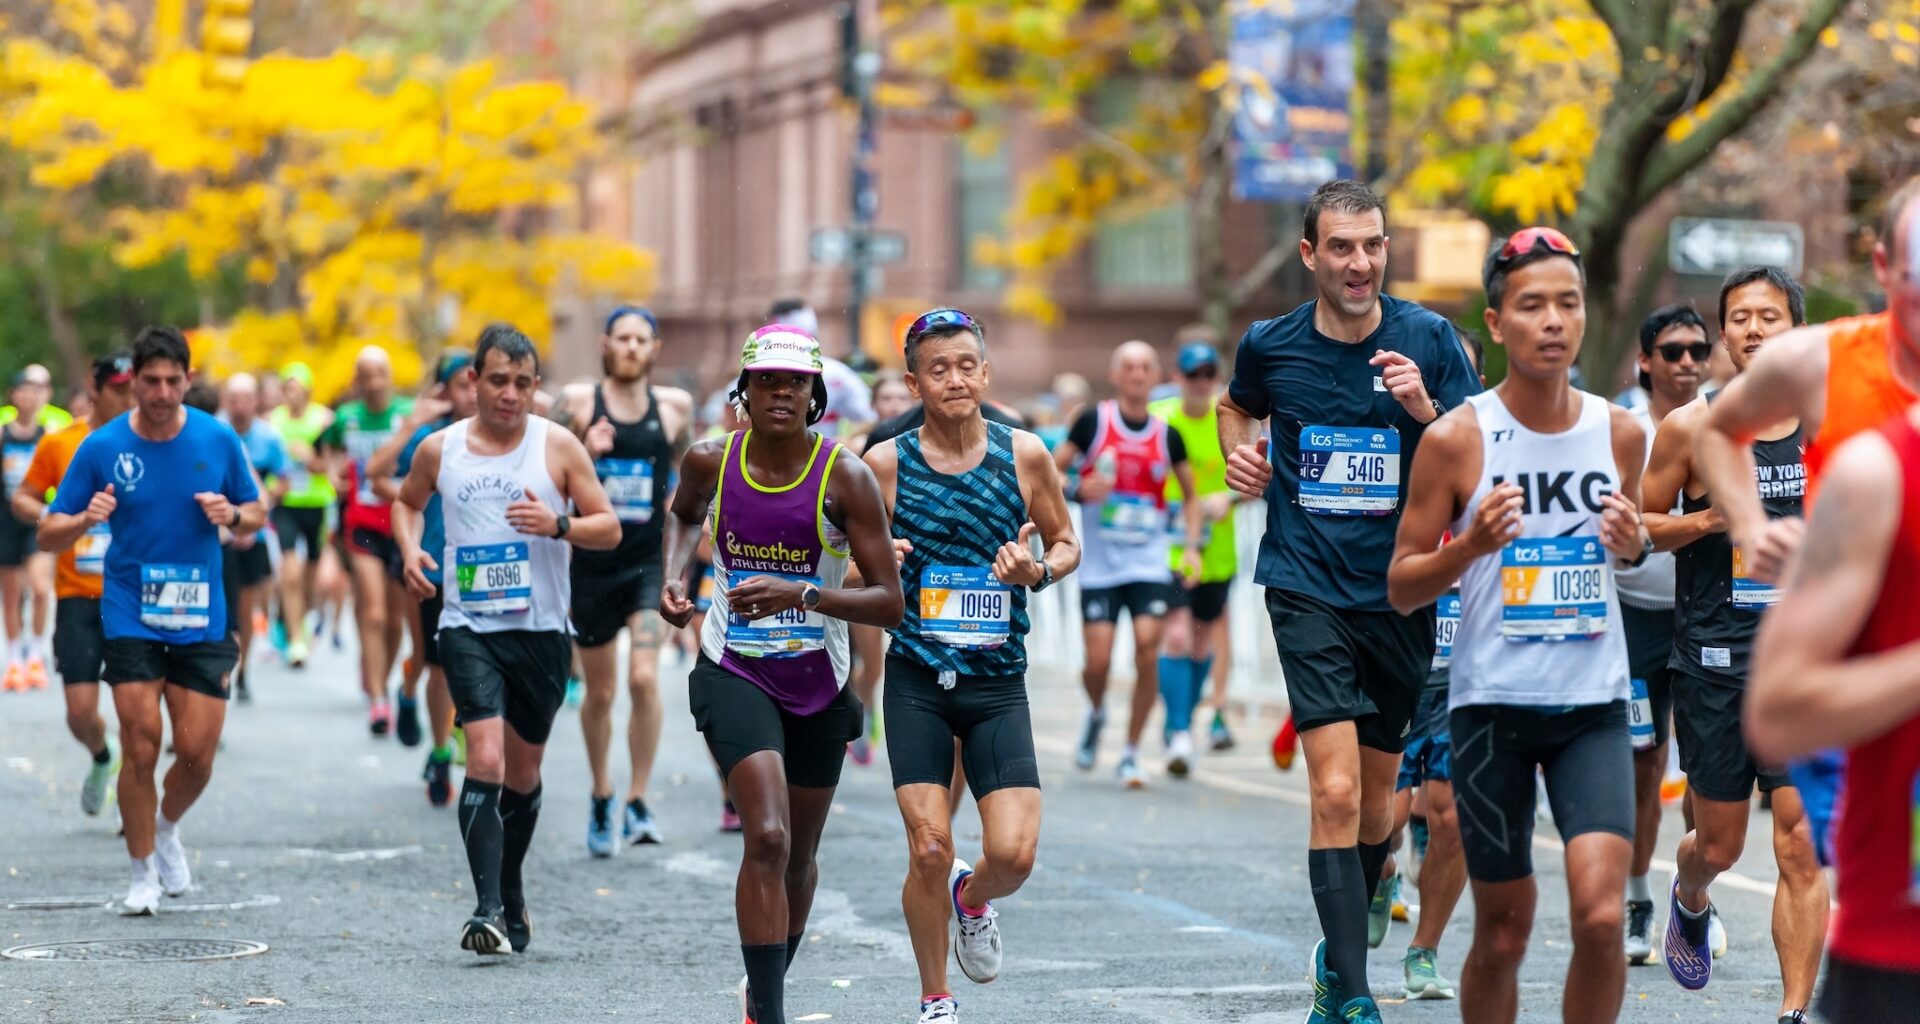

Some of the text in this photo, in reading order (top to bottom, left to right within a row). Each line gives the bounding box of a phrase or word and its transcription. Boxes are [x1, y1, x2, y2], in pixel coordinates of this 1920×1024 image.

[765, 341, 811, 353] &mothe
[1311, 432, 1332, 447] tcs
[1310, 468, 1319, 478] C
[1347, 455, 1384, 483] 5416
[1752, 466, 1773, 481] EW
[458, 476, 522, 503] CHICAGO
[1341, 486, 1365, 495] 2022
[1492, 470, 1613, 516] HKG
[1759, 479, 1809, 499] RRIER
[726, 531, 810, 562] &mother
[731, 558, 812, 574] ATHLETIC CLUB
[486, 564, 522, 588] 6698
[929, 571, 950, 585] tcs
[1553, 569, 1601, 601] 10389
[929, 605, 938, 615] E
[961, 593, 1002, 619] 10199
[768, 630, 791, 638] 2022
